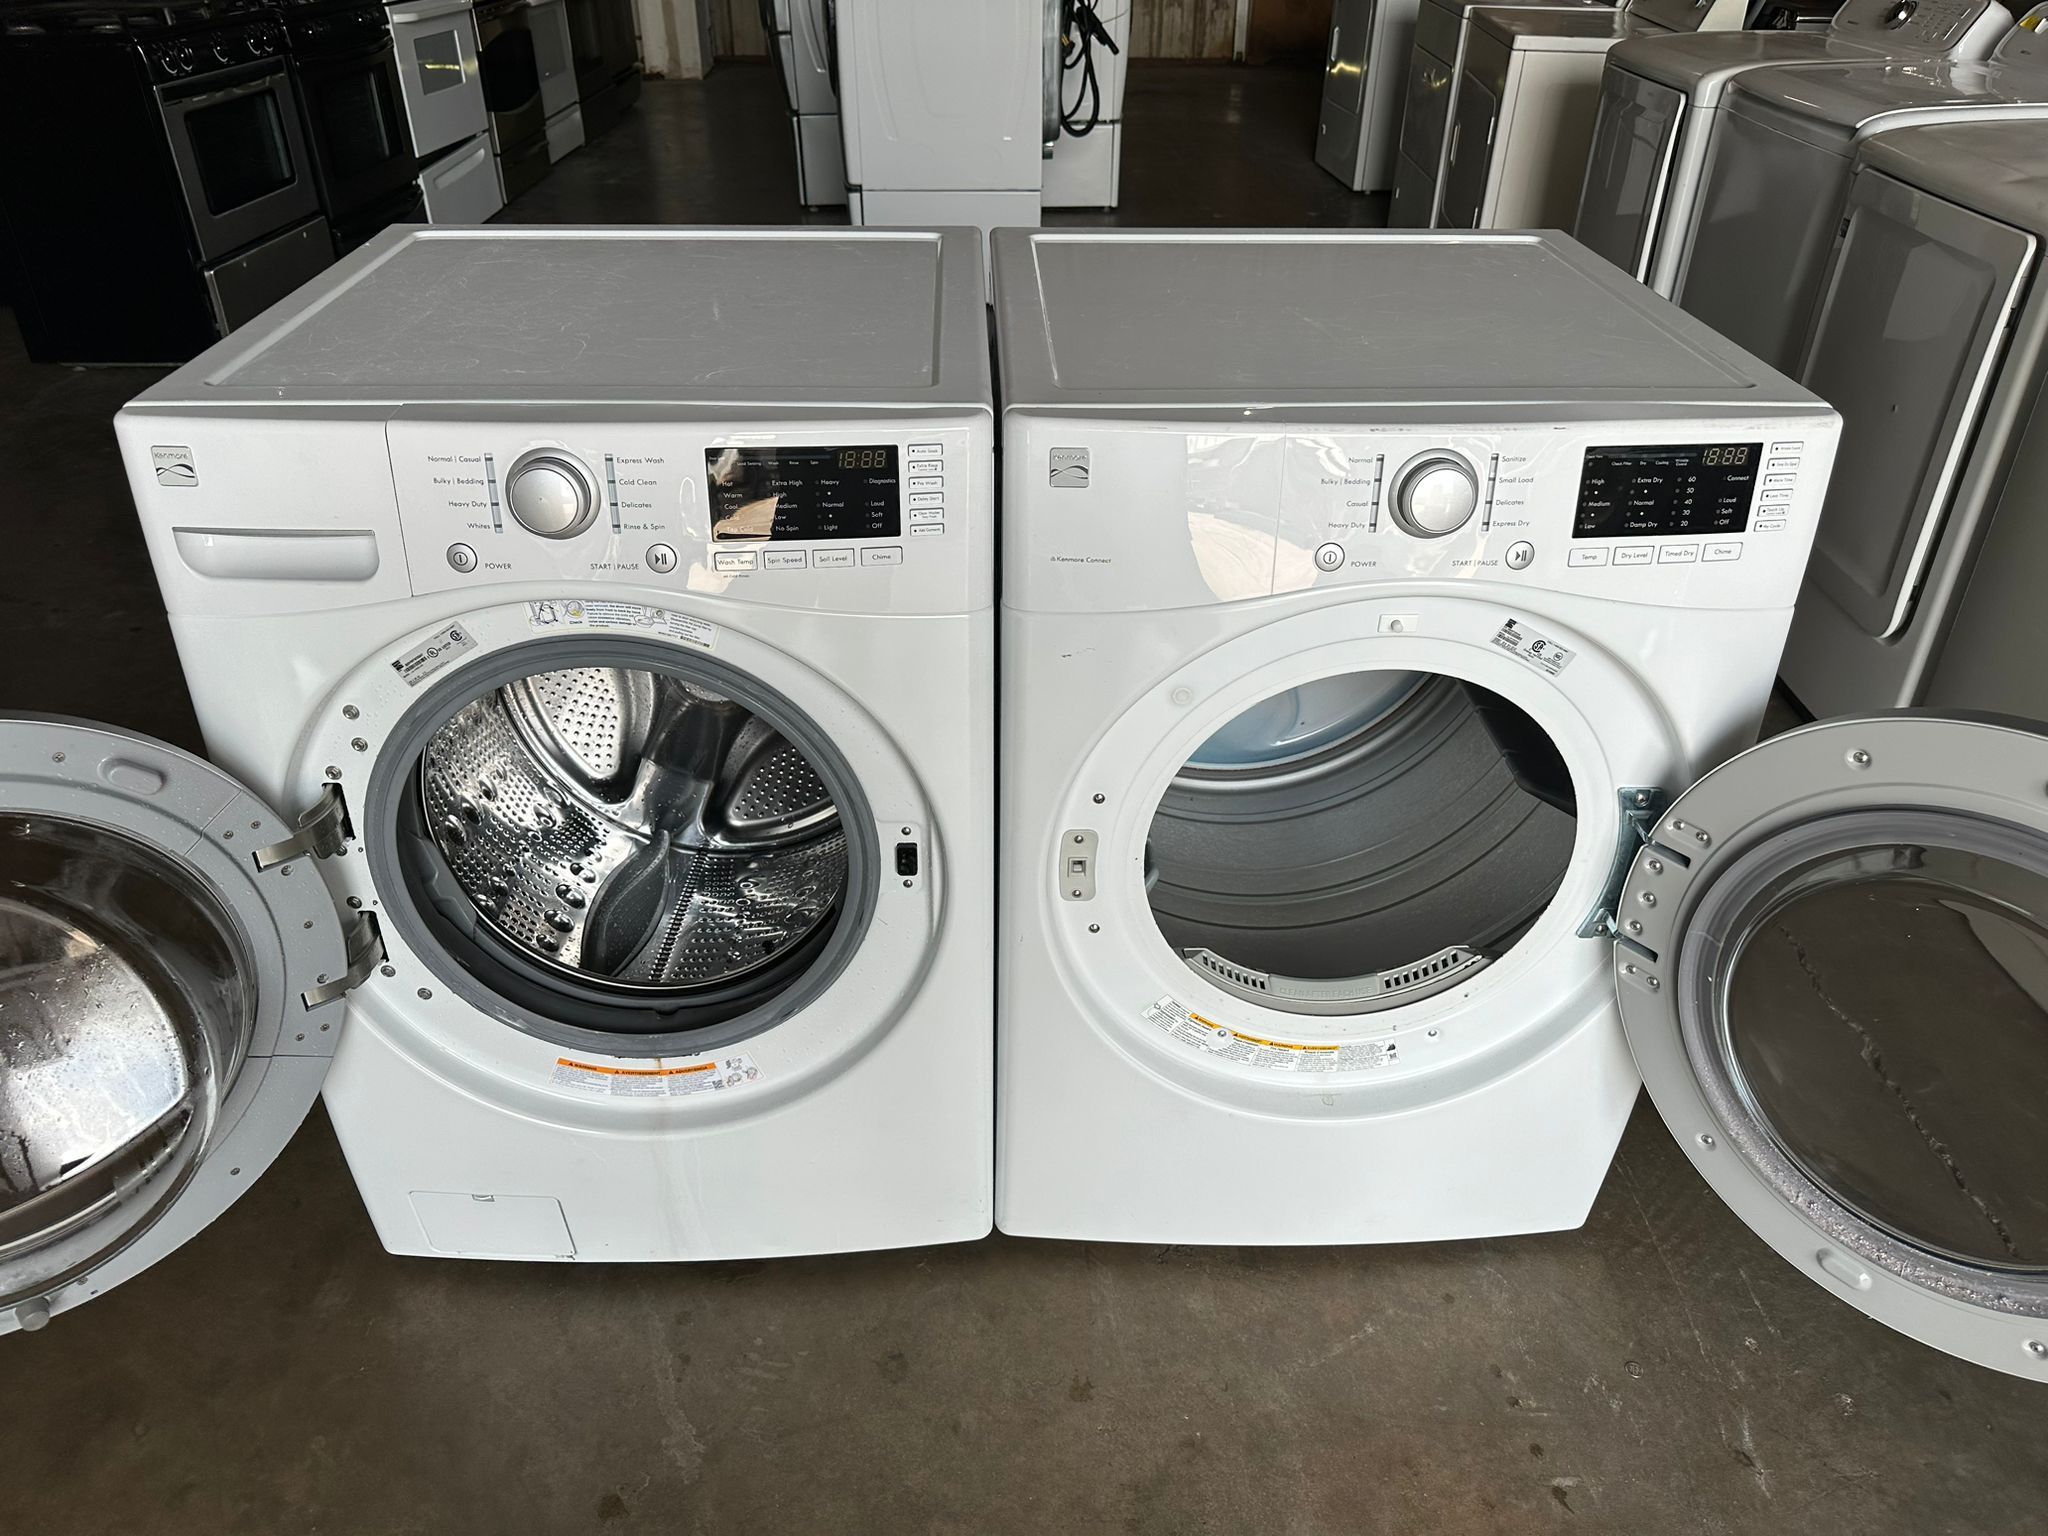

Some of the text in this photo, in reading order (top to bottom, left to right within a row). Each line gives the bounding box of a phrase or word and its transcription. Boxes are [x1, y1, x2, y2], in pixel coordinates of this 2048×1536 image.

[433, 477, 484, 485] Bulky Bedding
[1344, 478, 1371, 486] Bedding
